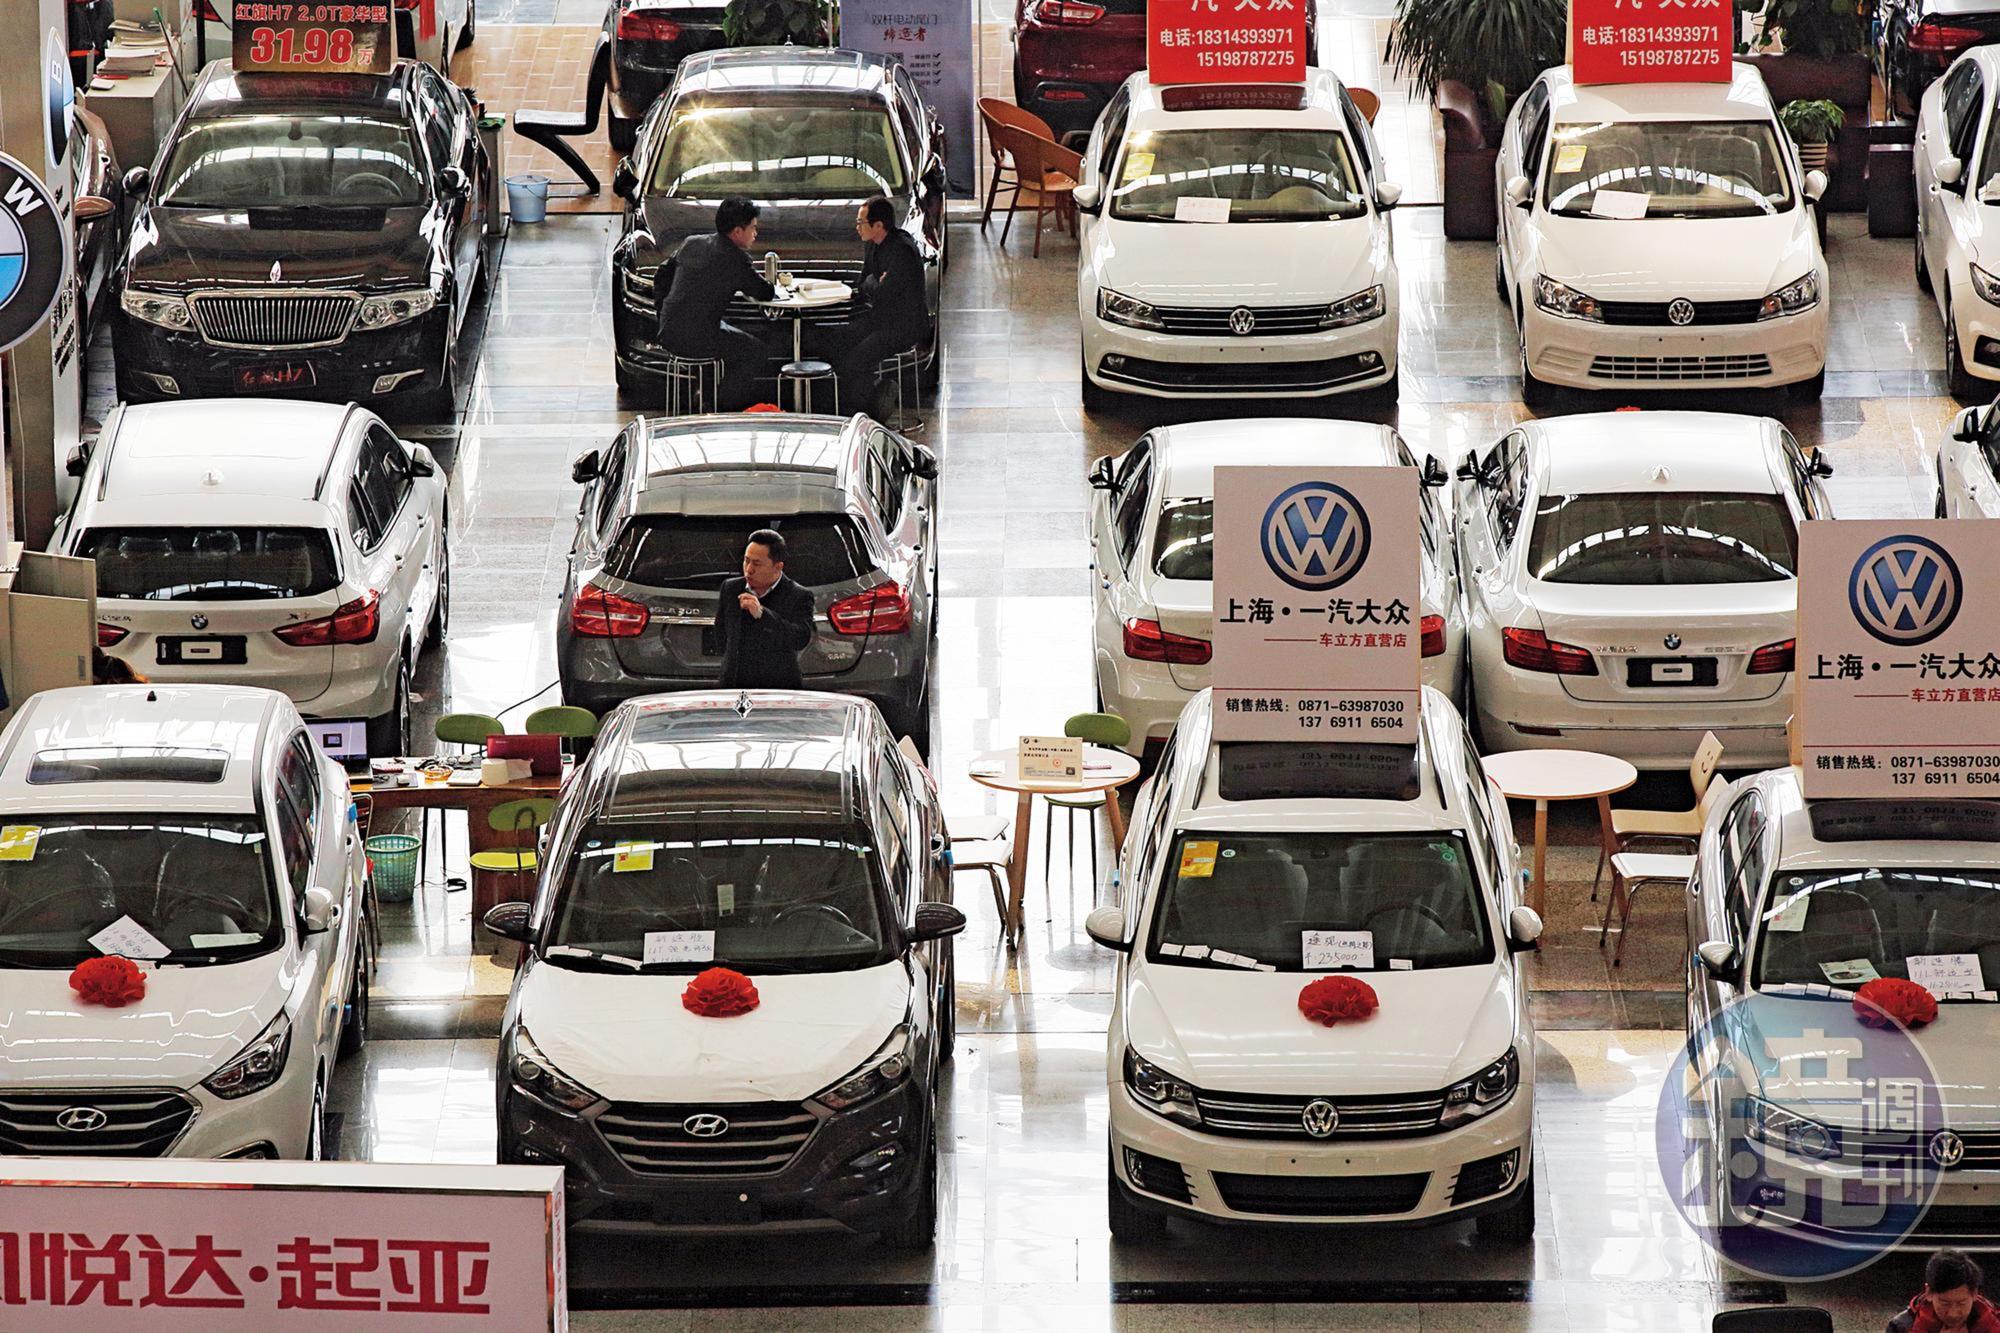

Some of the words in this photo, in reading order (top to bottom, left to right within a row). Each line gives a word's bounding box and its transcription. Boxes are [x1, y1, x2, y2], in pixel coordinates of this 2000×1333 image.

[235, 4, 293, 20] 红旗H7
[298, 5, 387, 23] 2.0T豪华型
[1160, 28, 1293, 46] 电话:18314393971
[1583, 26, 1718, 45] 电话:18314393971
[251, 27, 353, 64] 31.98
[358, 48, 374, 65] 万
[1197, 50, 1295, 66] 15198787275
[1620, 49, 1720, 65] 15198787275
[1220, 597, 1411, 625] 上海·一汽大众
[1319, 633, 1407, 648] 车立方直营店
[1911, 688, 2000, 702] 车立方直营店
[1298, 700, 1404, 712] 0871-63987030
[1298, 716, 1321, 728] 137
[1330, 716, 1362, 728] 6911
[1370, 716, 1404, 728] 6504
[1890, 756, 2000, 768] 0871-63987030
[1891, 773, 1916, 784] 137
[1924, 773, 1957, 784] 6911
[1966, 773, 2000, 784] 6504
[0, 1231, 491, 1315] 悦达·起亚
